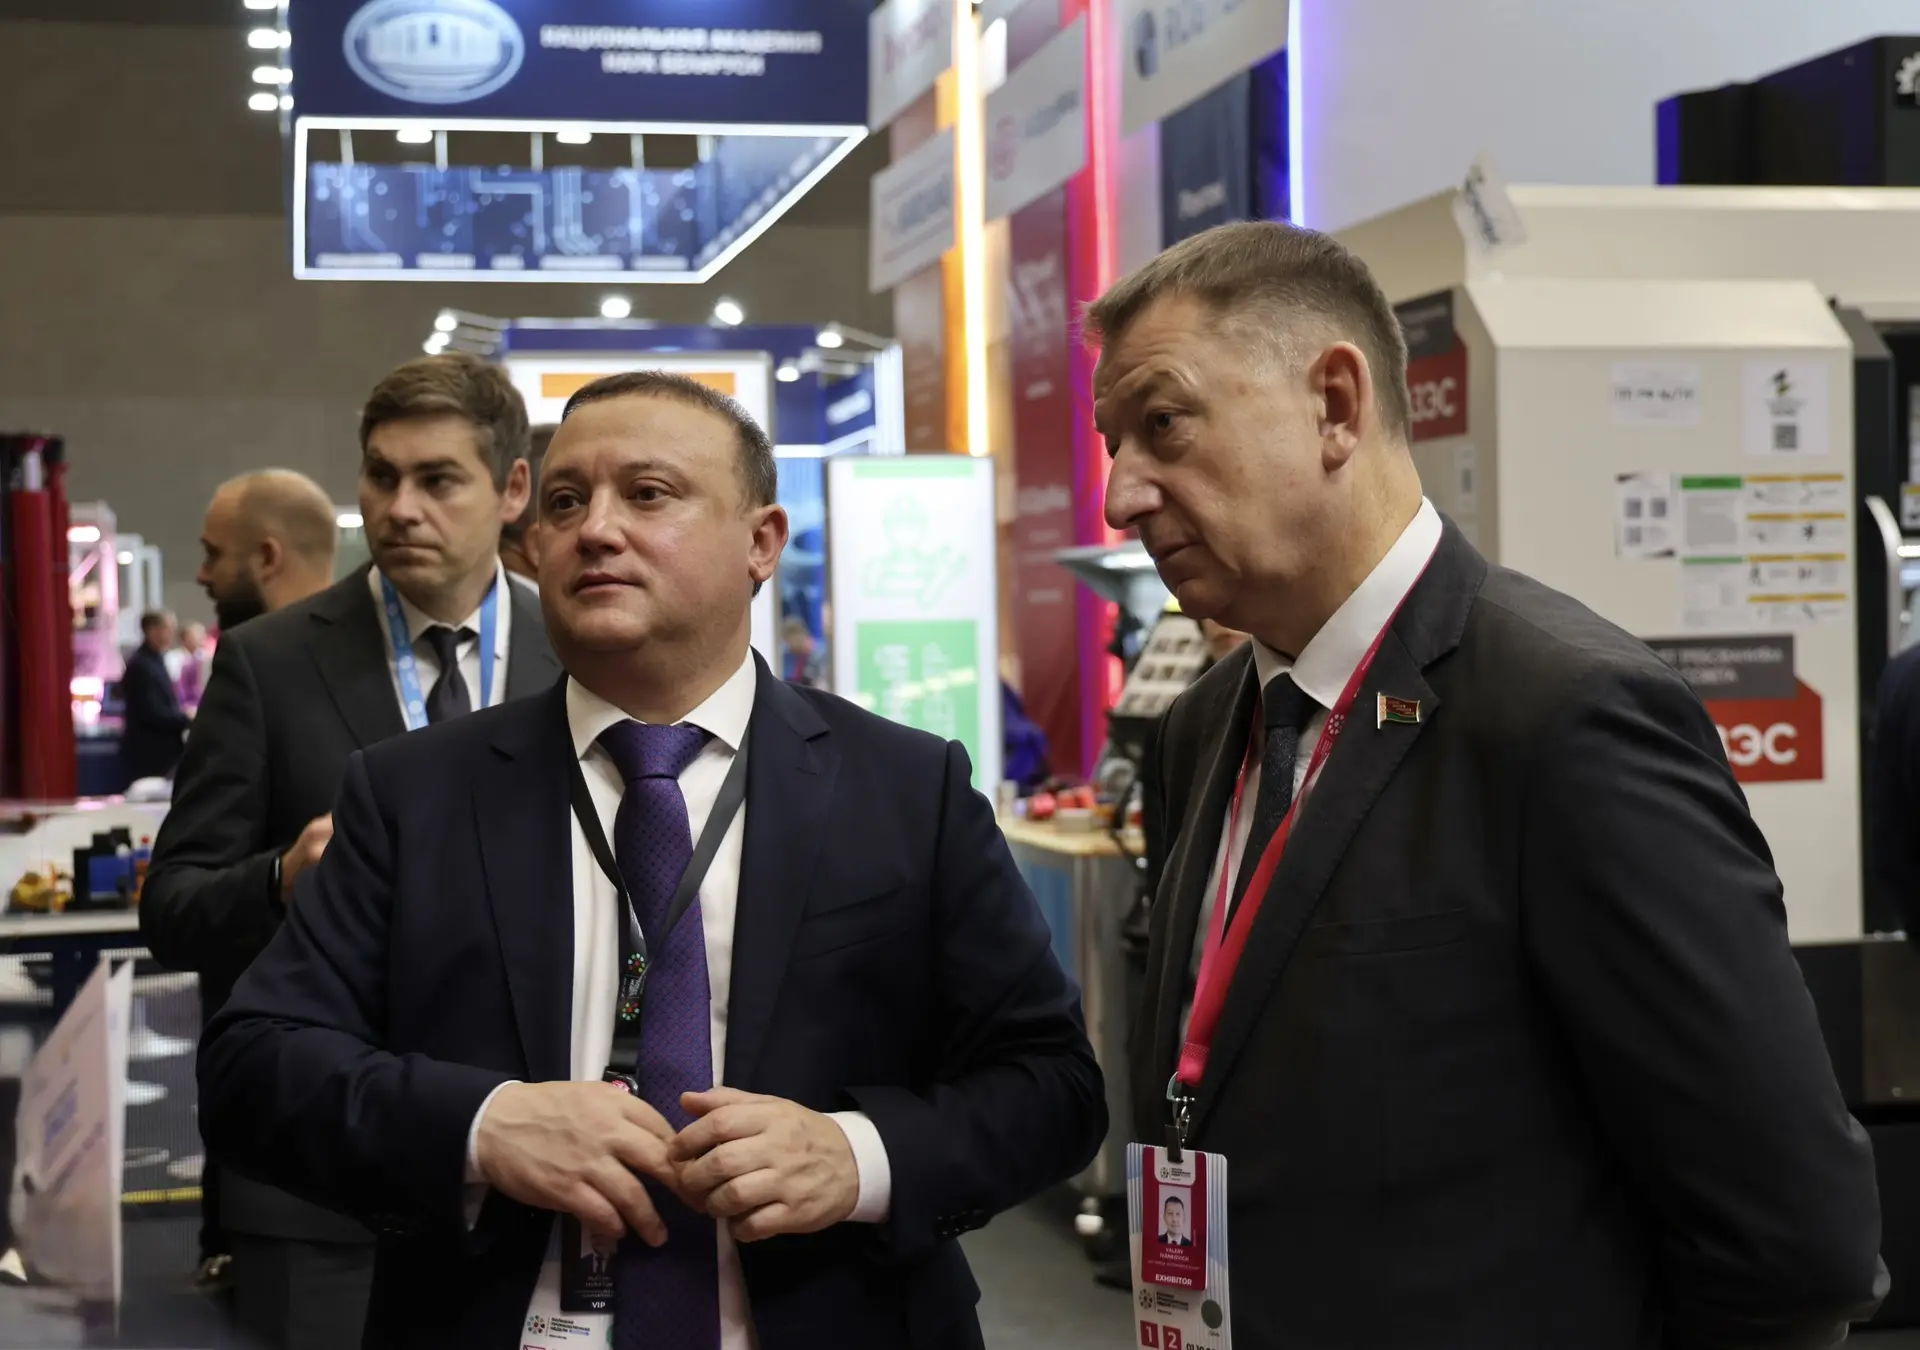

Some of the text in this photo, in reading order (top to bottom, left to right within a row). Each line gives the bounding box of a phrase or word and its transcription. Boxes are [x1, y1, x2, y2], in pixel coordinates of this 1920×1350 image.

[1155, 1273, 1193, 1286] EXHIBITOR
[591, 1301, 606, 1309] VIP
[1145, 1325, 1153, 1343] 1
[1167, 1331, 1178, 1349] 2
